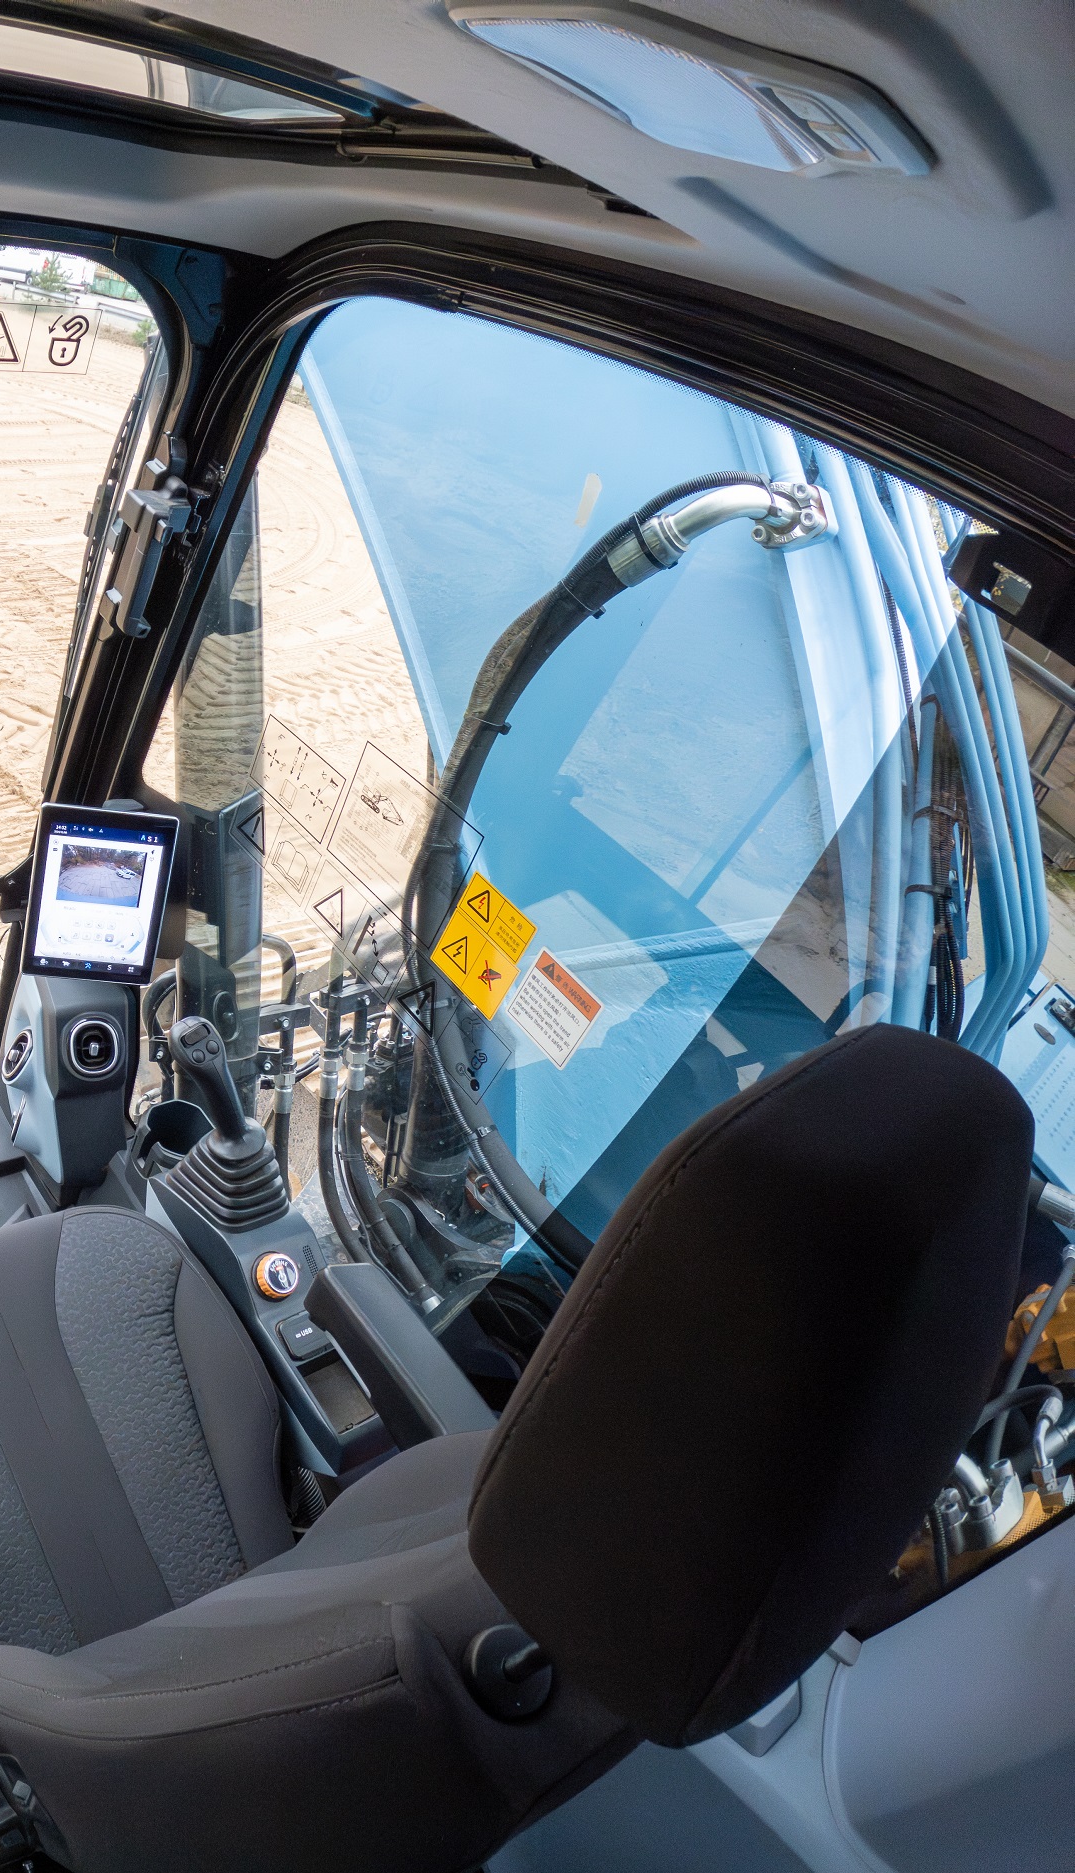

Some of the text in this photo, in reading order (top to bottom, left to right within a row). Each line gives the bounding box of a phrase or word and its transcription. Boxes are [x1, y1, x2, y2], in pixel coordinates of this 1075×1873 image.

[529, 994, 537, 1003] sure
[542, 1008, 552, 1019] open
[567, 986, 591, 1012] WARNING
[515, 1000, 533, 1020] otherwise
[533, 1018, 543, 1030] there
[550, 1037, 563, 1052] safety
[520, 994, 529, 1005] when
[529, 1004, 544, 1022] working
[544, 1020, 552, 1029] with
[553, 1029, 563, 1040] warm
[300, 1327, 313, 1337] USB
